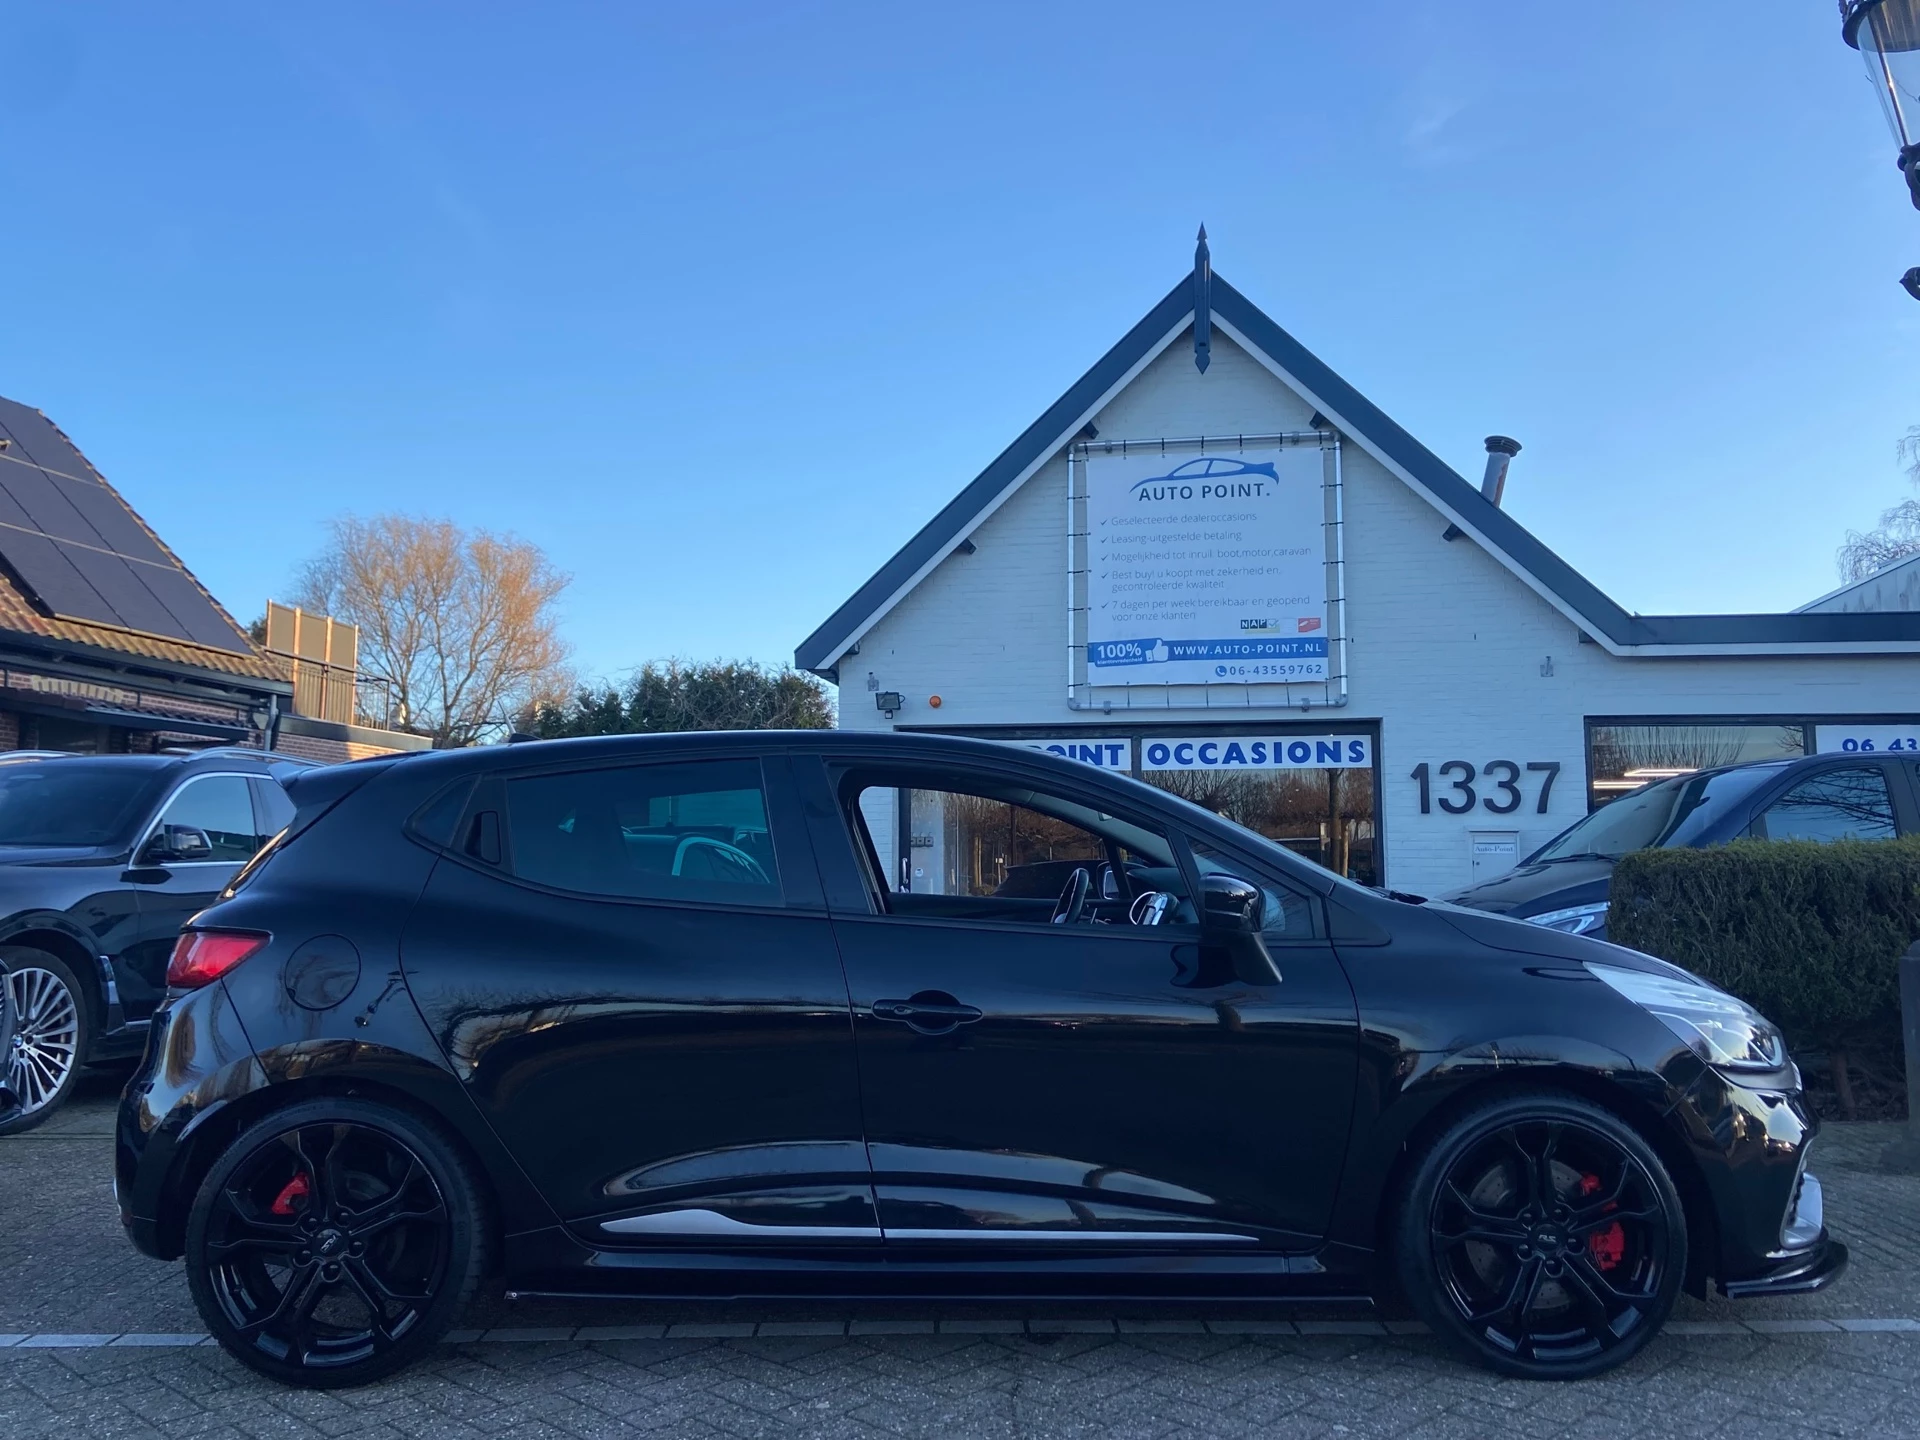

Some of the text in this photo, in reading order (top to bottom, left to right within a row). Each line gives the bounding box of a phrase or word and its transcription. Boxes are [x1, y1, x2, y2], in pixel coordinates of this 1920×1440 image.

[1138, 483, 1270, 501] AUTO POINT.
[1112, 513, 1257, 526] Geselecteerde dealeroccasions
[1204, 531, 1243, 542] betaling
[1112, 551, 1170, 563] Mogelijkheid
[1112, 570, 1133, 580] Best
[1166, 569, 1193, 580] koopt
[1218, 566, 1264, 576] zekerheid
[1112, 580, 1224, 594] gecontroleerde kwaliteit
[1112, 600, 1118, 609] 7
[1120, 600, 1150, 611] dagen
[1152, 601, 1167, 610] per
[1170, 599, 1196, 608] week
[1198, 598, 1249, 607] bereikbaar
[1266, 596, 1310, 607] geopend
[1162, 611, 1196, 620] klanten
[1242, 619, 1267, 628] NAP
[1098, 643, 1142, 658] 100%
[1174, 643, 1322, 655] WWW.AUTO-POINT.NL
[1230, 664, 1322, 675] 06-43559762
[1842, 738, 1875, 751] 06
[1148, 741, 1365, 765] OCCASIONS
[1412, 760, 1560, 814] 1337
